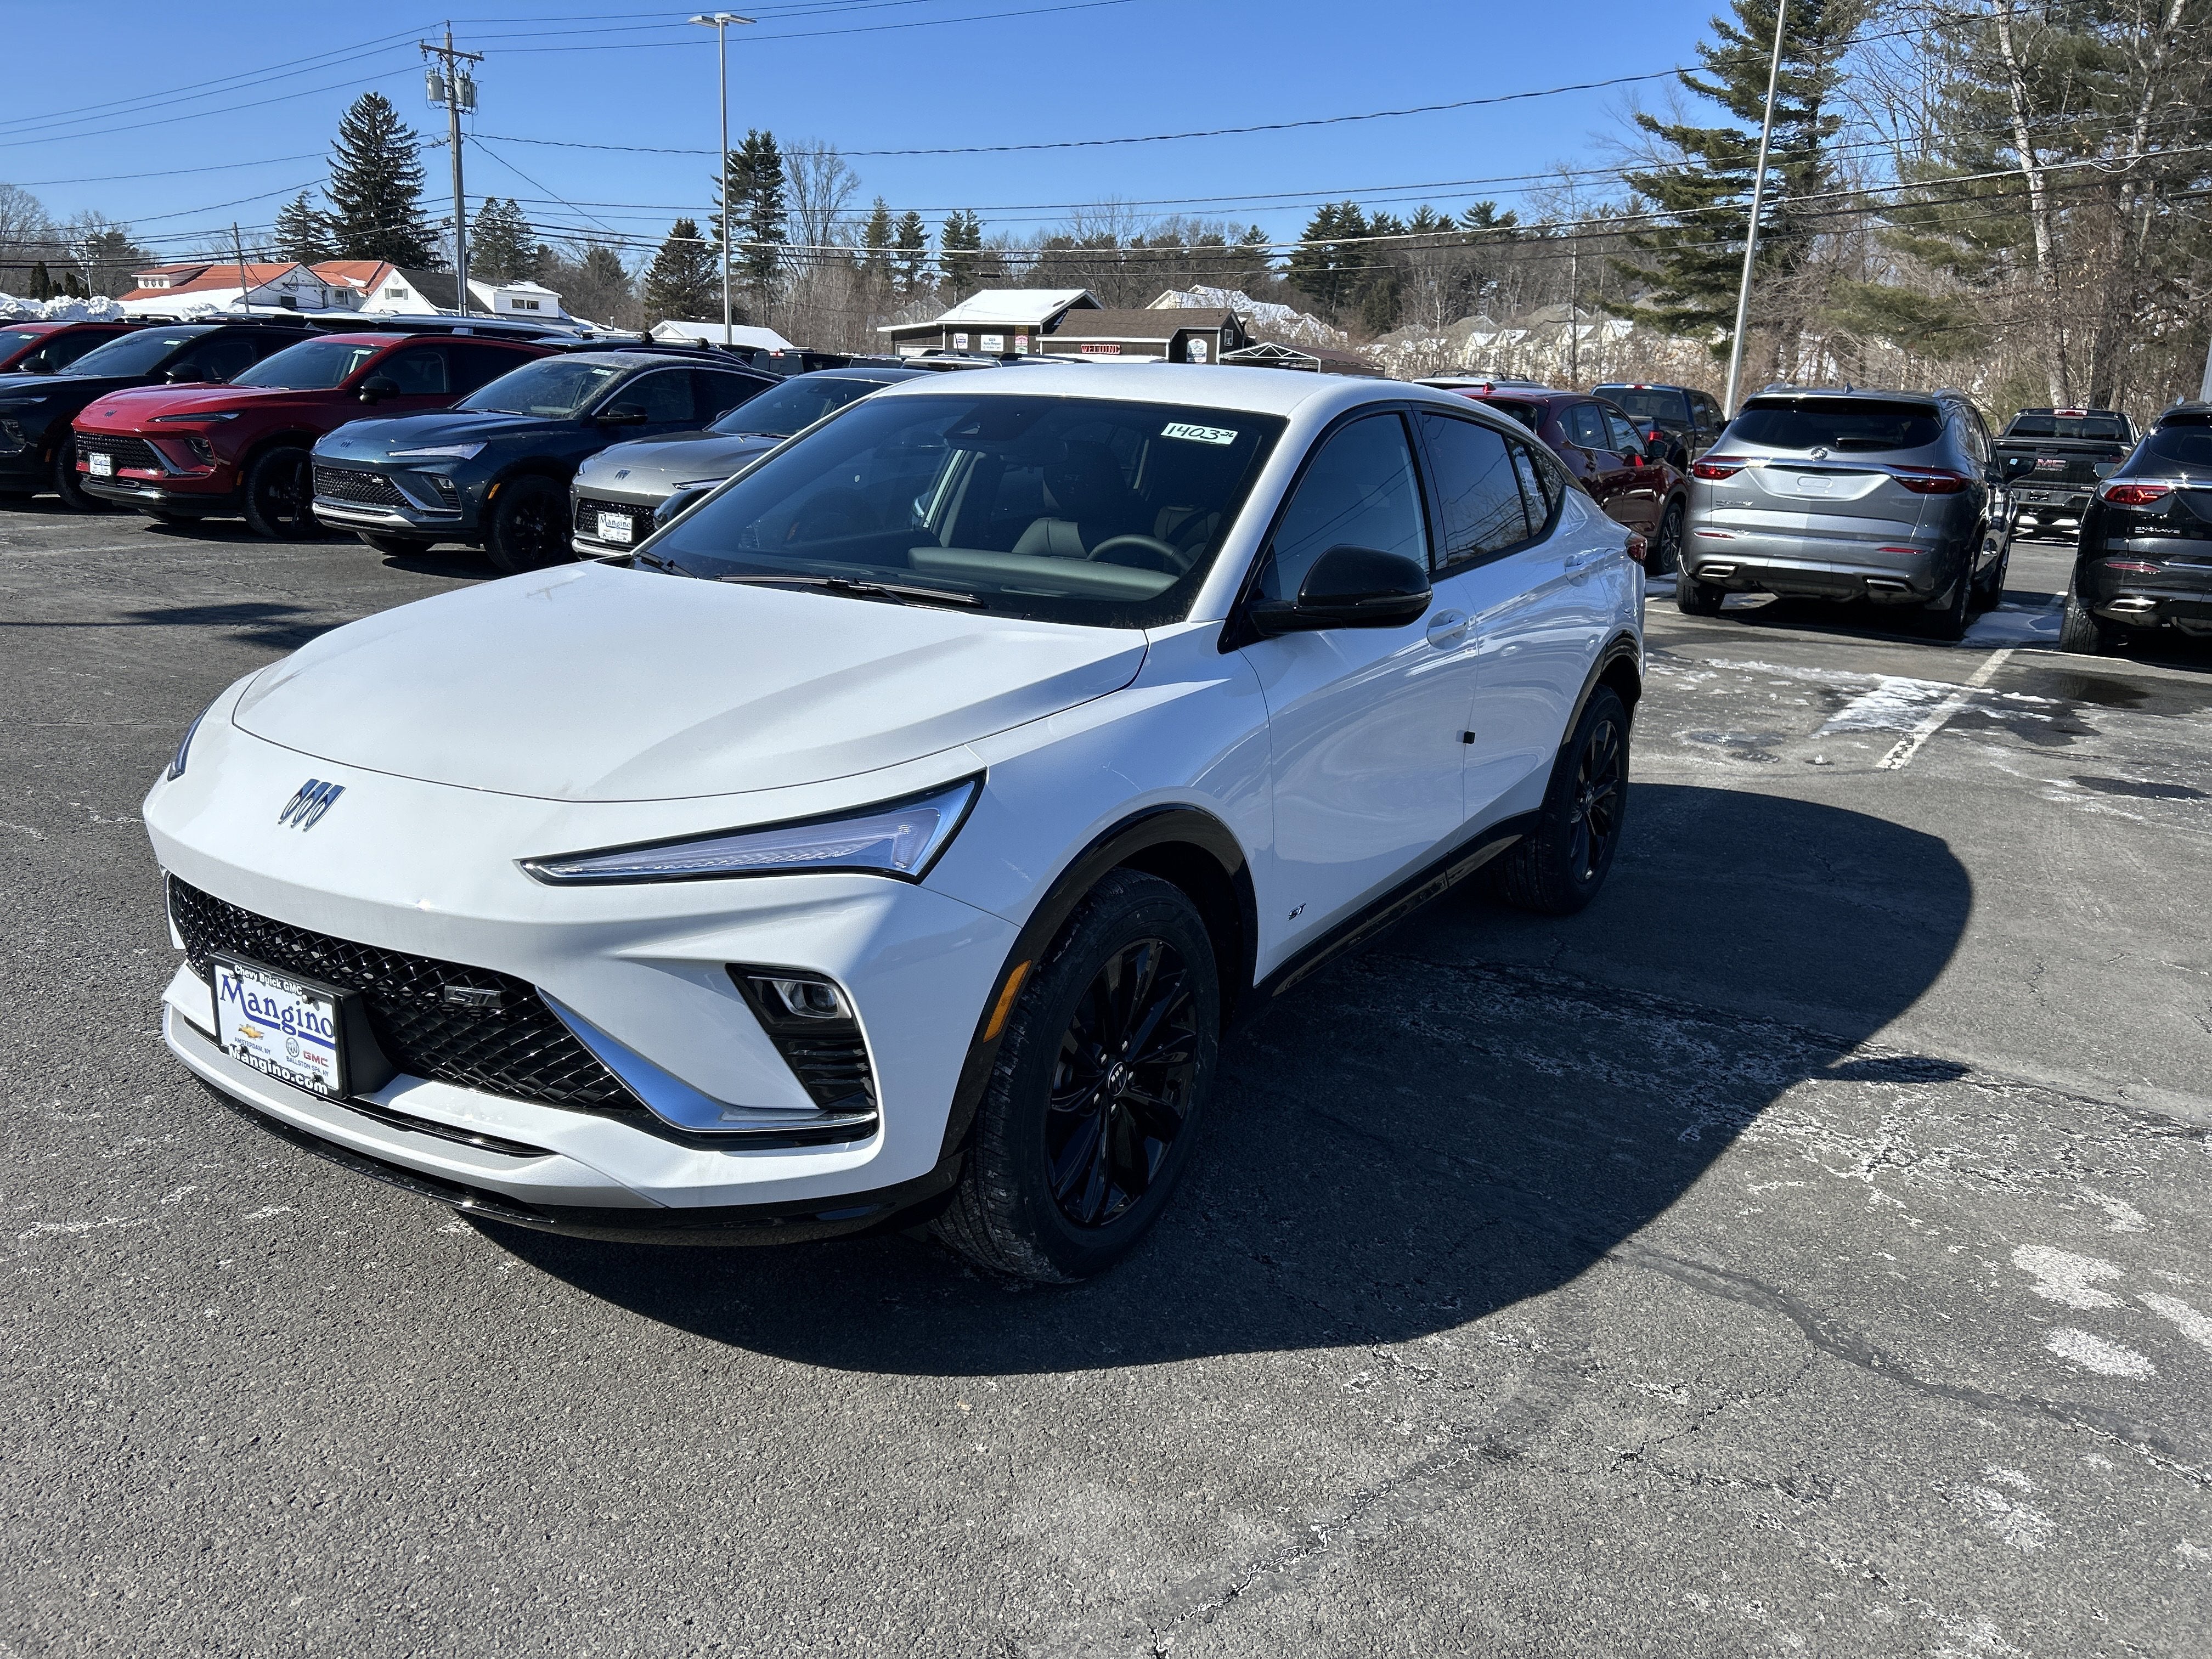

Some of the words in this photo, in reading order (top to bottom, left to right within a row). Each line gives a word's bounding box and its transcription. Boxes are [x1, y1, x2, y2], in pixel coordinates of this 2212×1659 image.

[1167, 425, 1221, 439] 1403
[2037, 459, 2067, 467] MC
[600, 515, 631, 529] Mangino
[234, 964, 258, 981] Chevy
[259, 973, 281, 989] Buick
[283, 981, 302, 995] GMC
[220, 973, 335, 1039] Mangino
[234, 1037, 263, 1053] AMSTERDAM,
[286, 1056, 311, 1069] BALLSTON
[303, 1050, 329, 1067] GMC
[229, 1043, 328, 1095] Mangino.com
